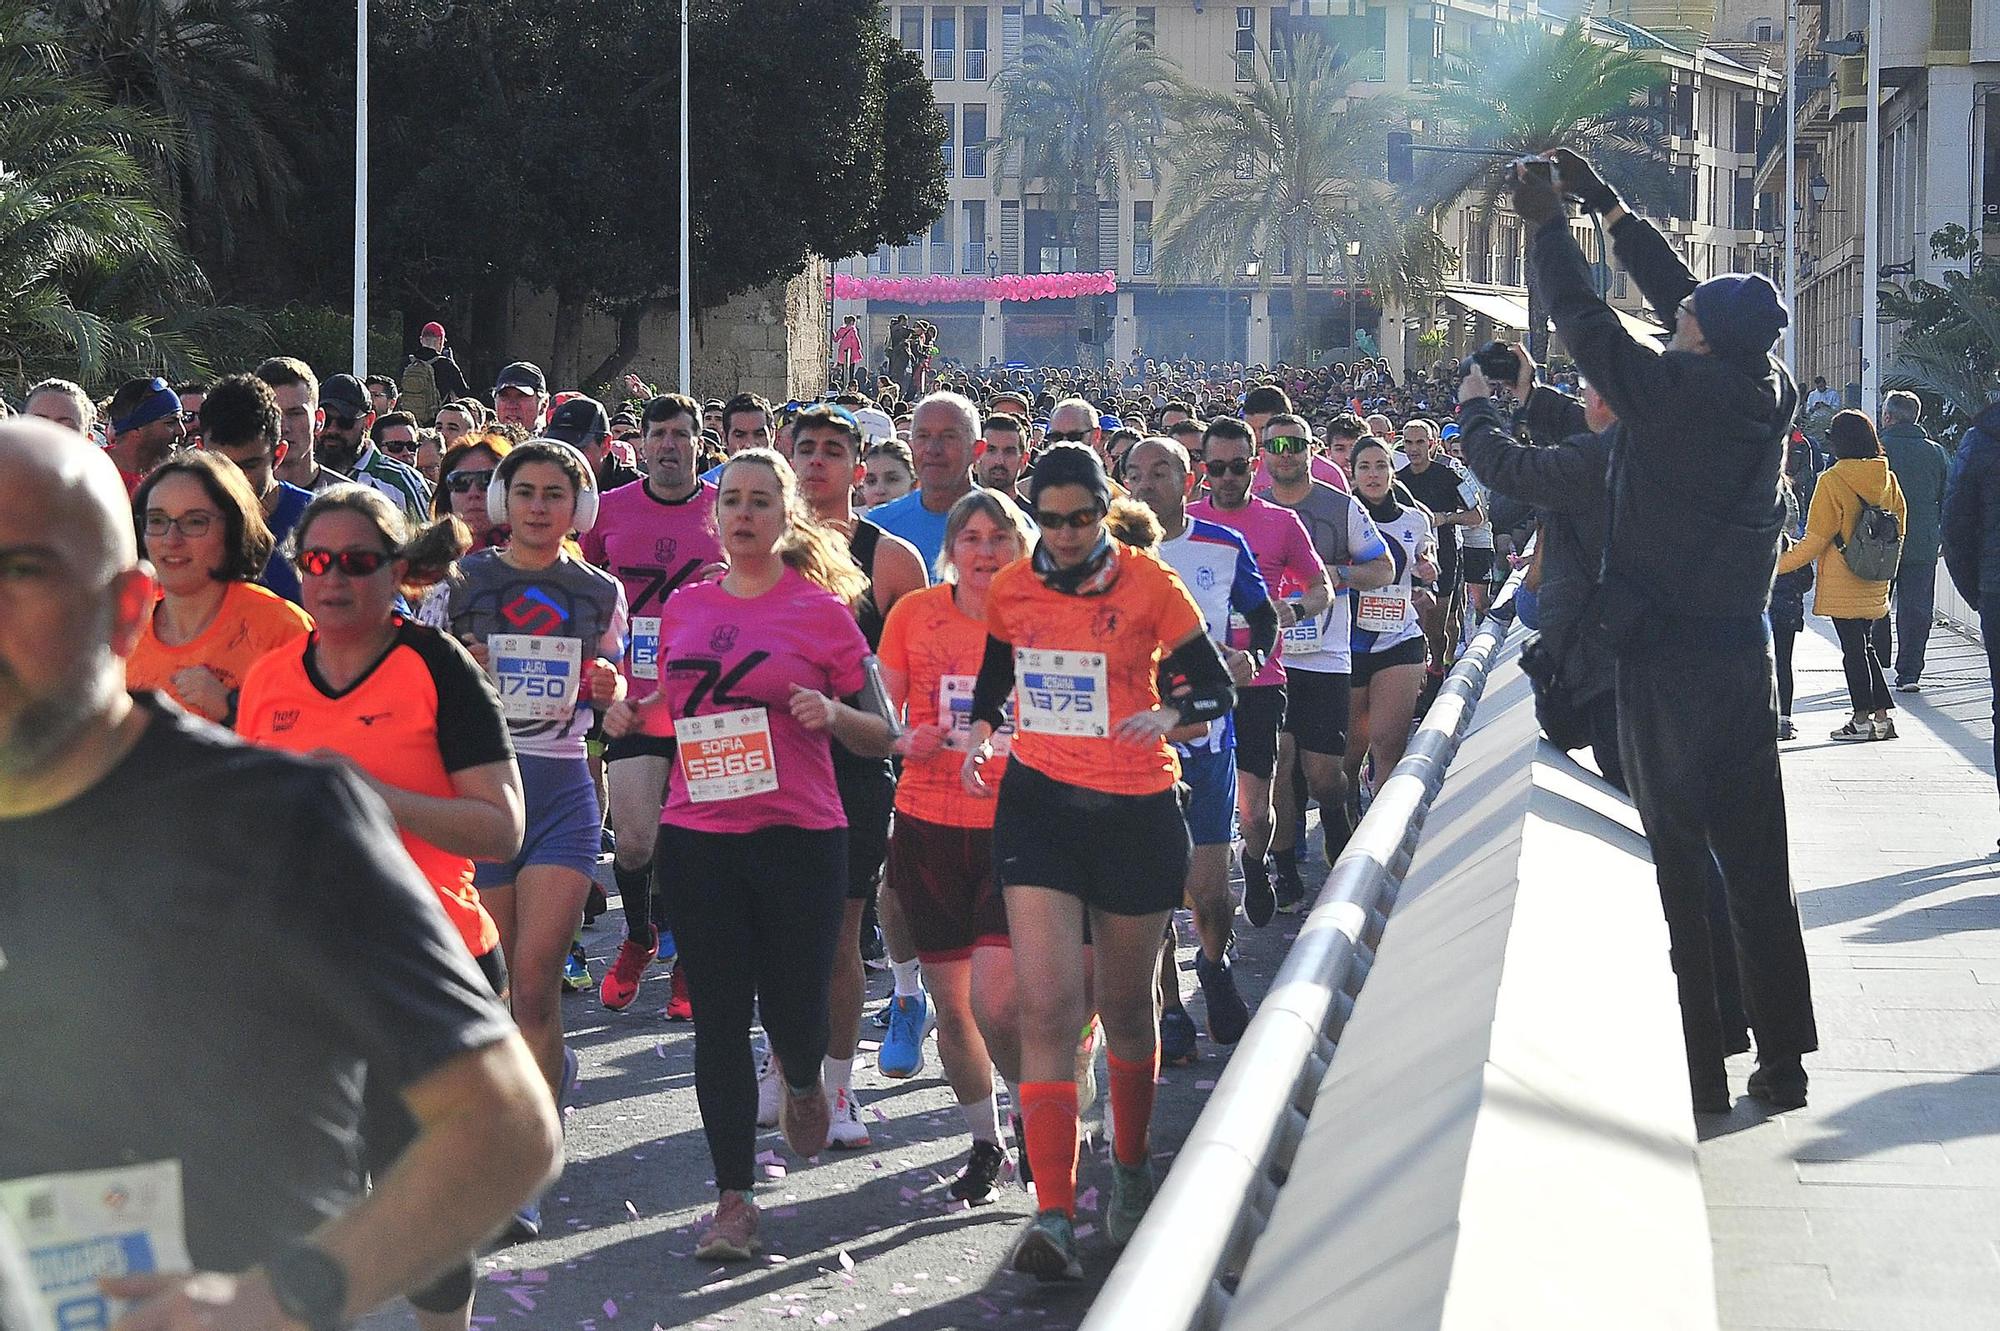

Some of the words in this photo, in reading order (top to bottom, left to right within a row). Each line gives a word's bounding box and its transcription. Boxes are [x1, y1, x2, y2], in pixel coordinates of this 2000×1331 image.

[1362, 606, 1402, 620] 5363
[520, 660, 547, 674] LAURA
[499, 675, 565, 698] 1750
[1028, 691, 1093, 713] 1375
[701, 736, 746, 755] SOFIA
[688, 749, 765, 780] 5366
